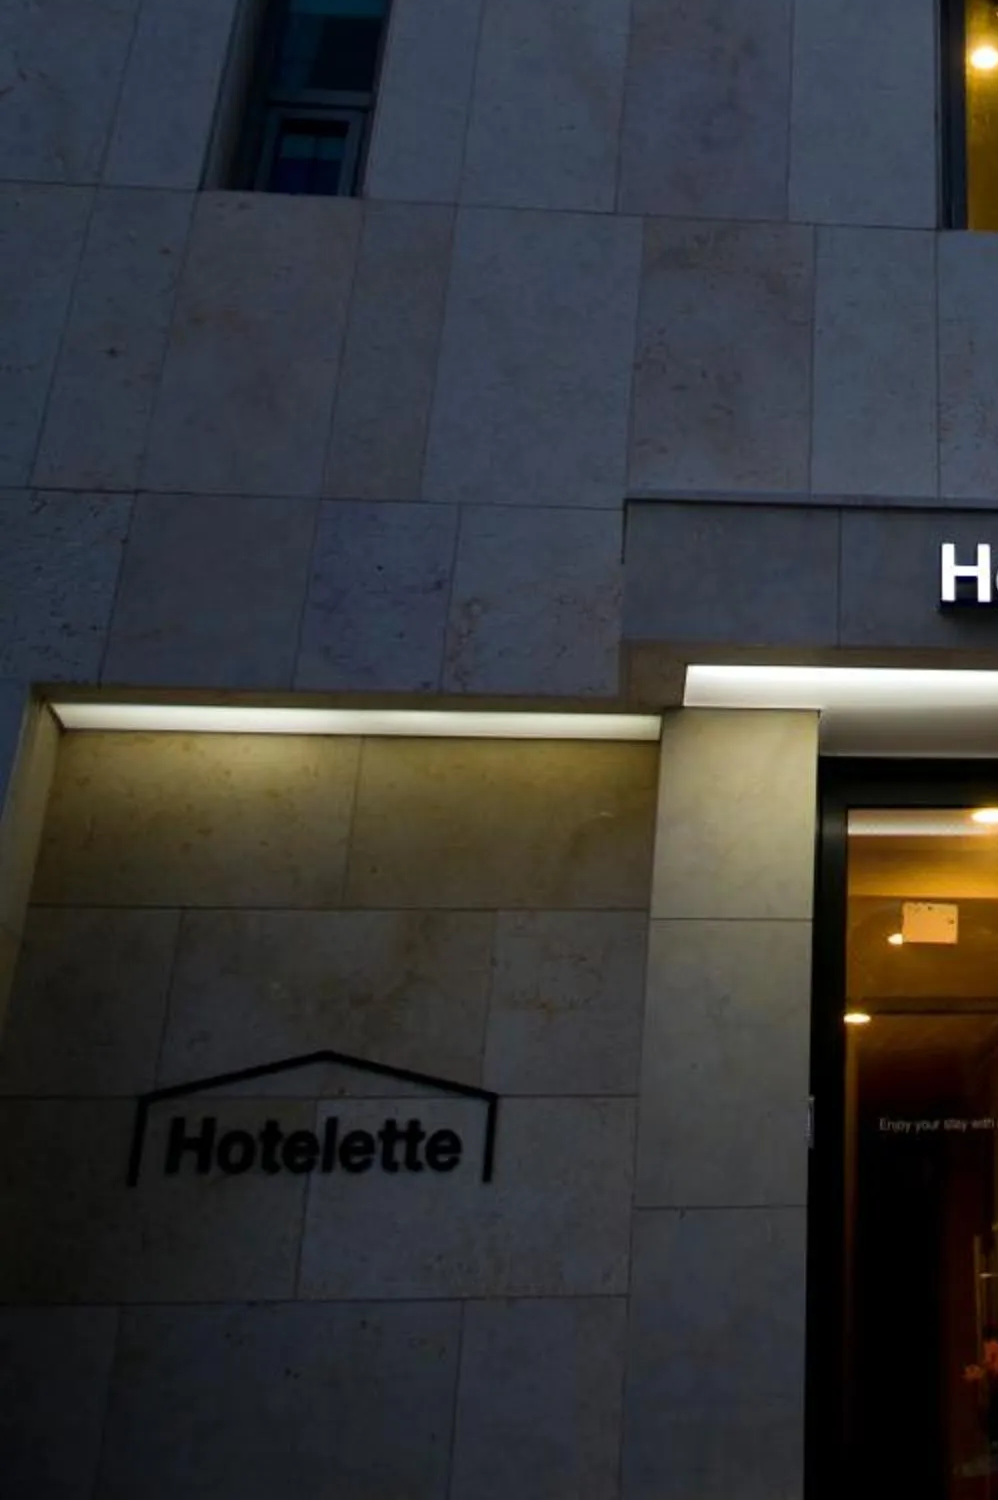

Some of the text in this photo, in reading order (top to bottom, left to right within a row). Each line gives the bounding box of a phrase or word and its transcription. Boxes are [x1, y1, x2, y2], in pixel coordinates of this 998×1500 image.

[879, 1117, 911, 1134] Enjoy
[915, 1119, 940, 1135] your
[943, 1118, 968, 1133] stay
[971, 1117, 994, 1129] with
[164, 1117, 463, 1174] Hotelette
